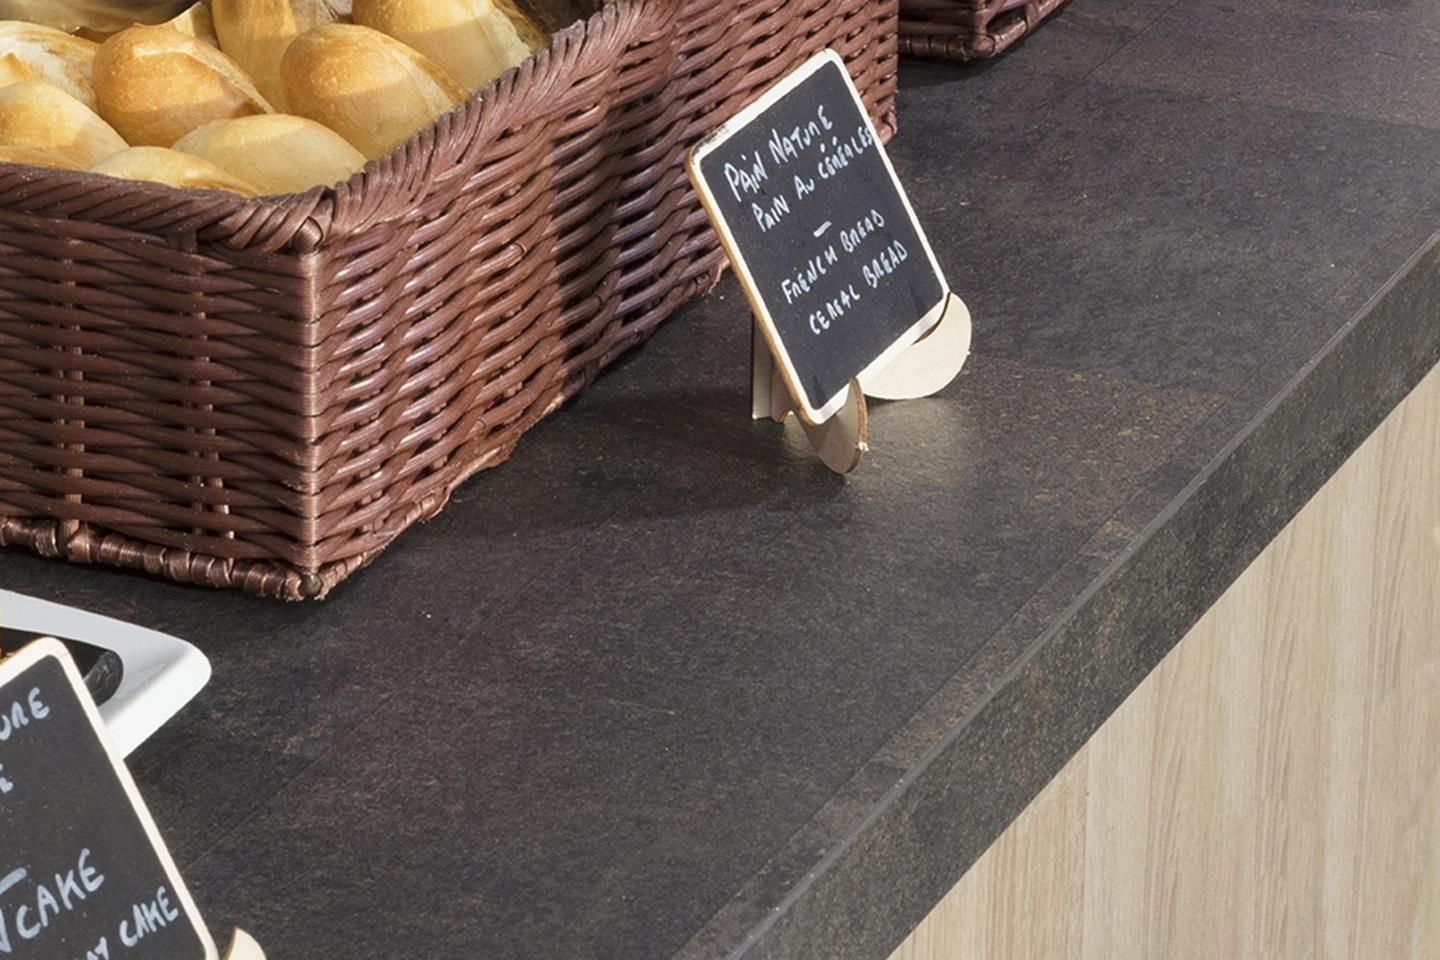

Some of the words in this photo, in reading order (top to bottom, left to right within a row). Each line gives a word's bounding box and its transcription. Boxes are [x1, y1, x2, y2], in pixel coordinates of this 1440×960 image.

[723, 153, 769, 204] PAIN
[770, 105, 833, 167] NATURE
[751, 196, 791, 234] PAIN
[794, 173, 816, 202] AU
[780, 247, 838, 306] FRENCH
[841, 207, 886, 254] BREAD
[808, 286, 861, 336] CEREAL
[862, 239, 909, 289] BREAD
[118, 885, 179, 948] CAKE
